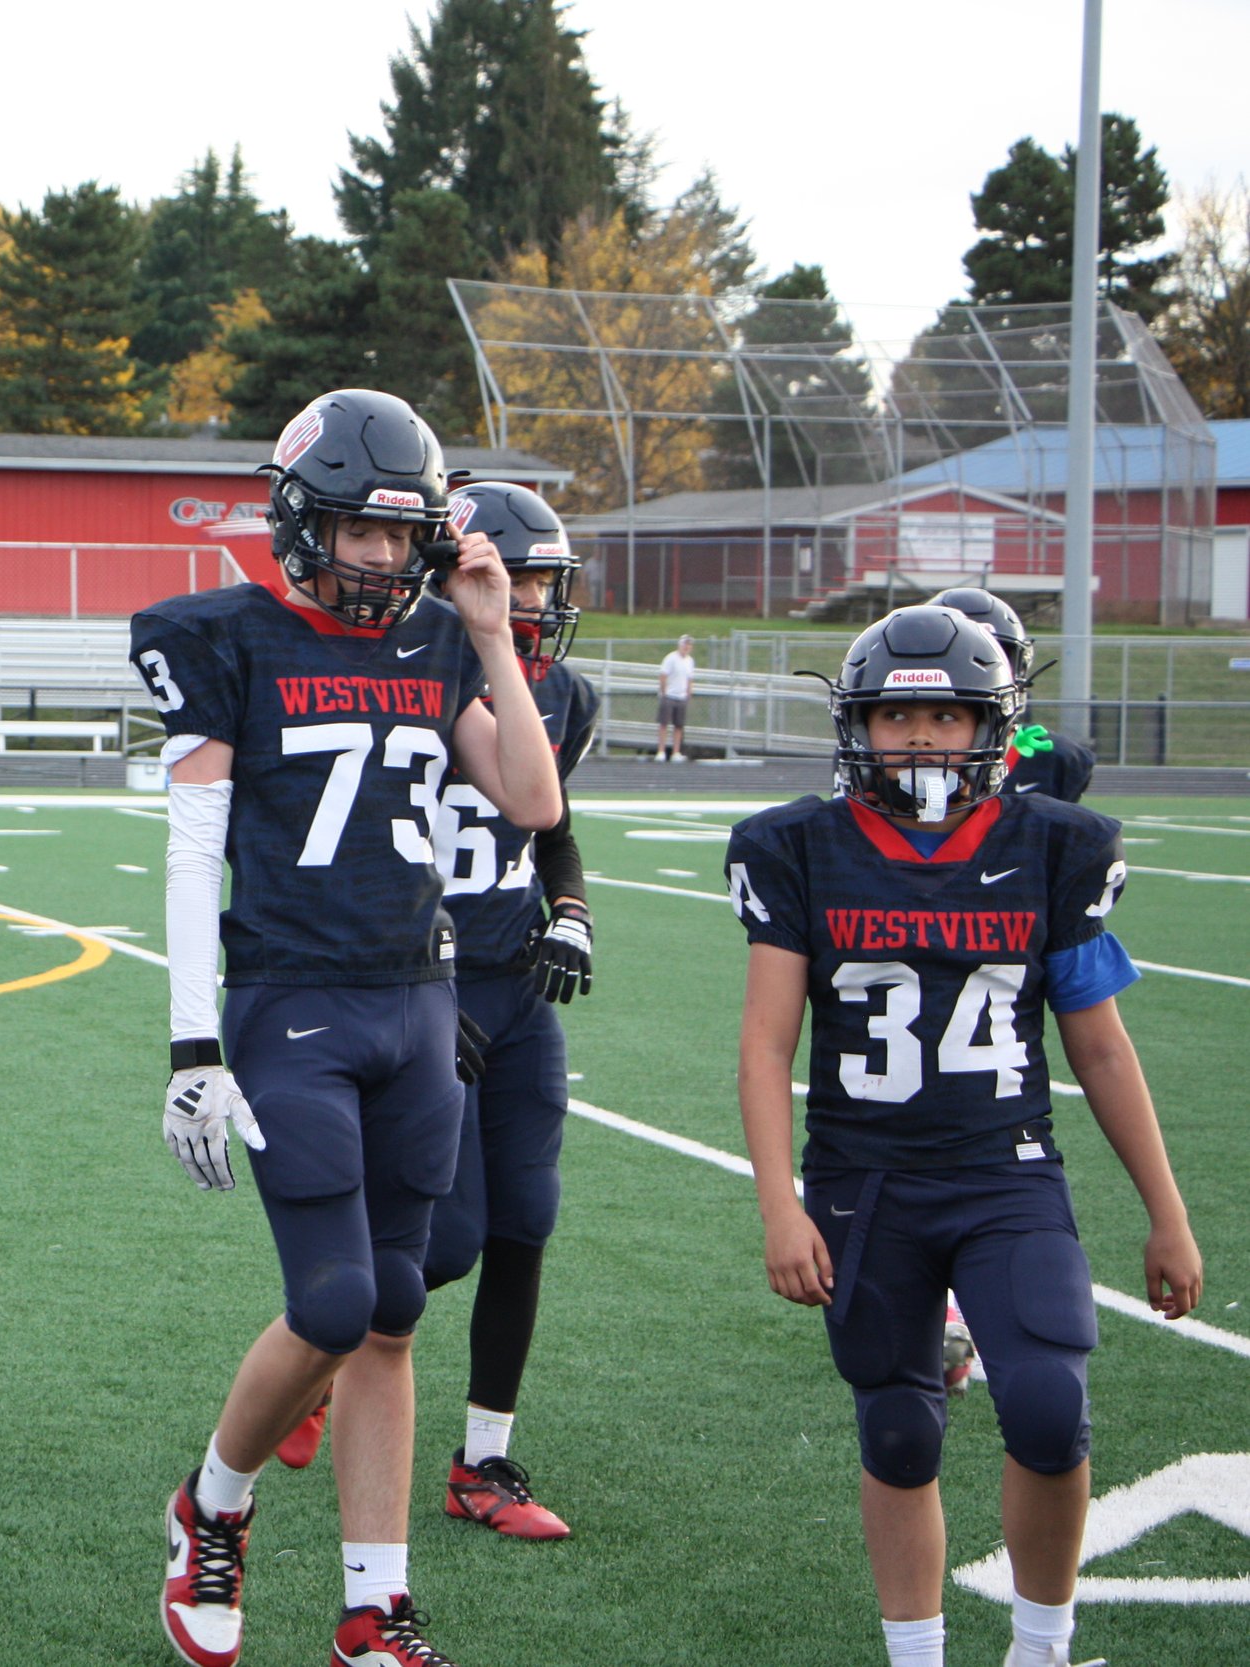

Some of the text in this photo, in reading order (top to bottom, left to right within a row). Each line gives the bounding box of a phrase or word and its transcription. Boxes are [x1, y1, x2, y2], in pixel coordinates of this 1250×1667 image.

[376, 493, 420, 507] Riddell
[276, 676, 444, 718] WESTVIEW
[893, 672, 943, 683] Riddell
[281, 722, 448, 867] 73
[825, 909, 1037, 951] WESTVIEW
[830, 961, 1030, 1104] 34
